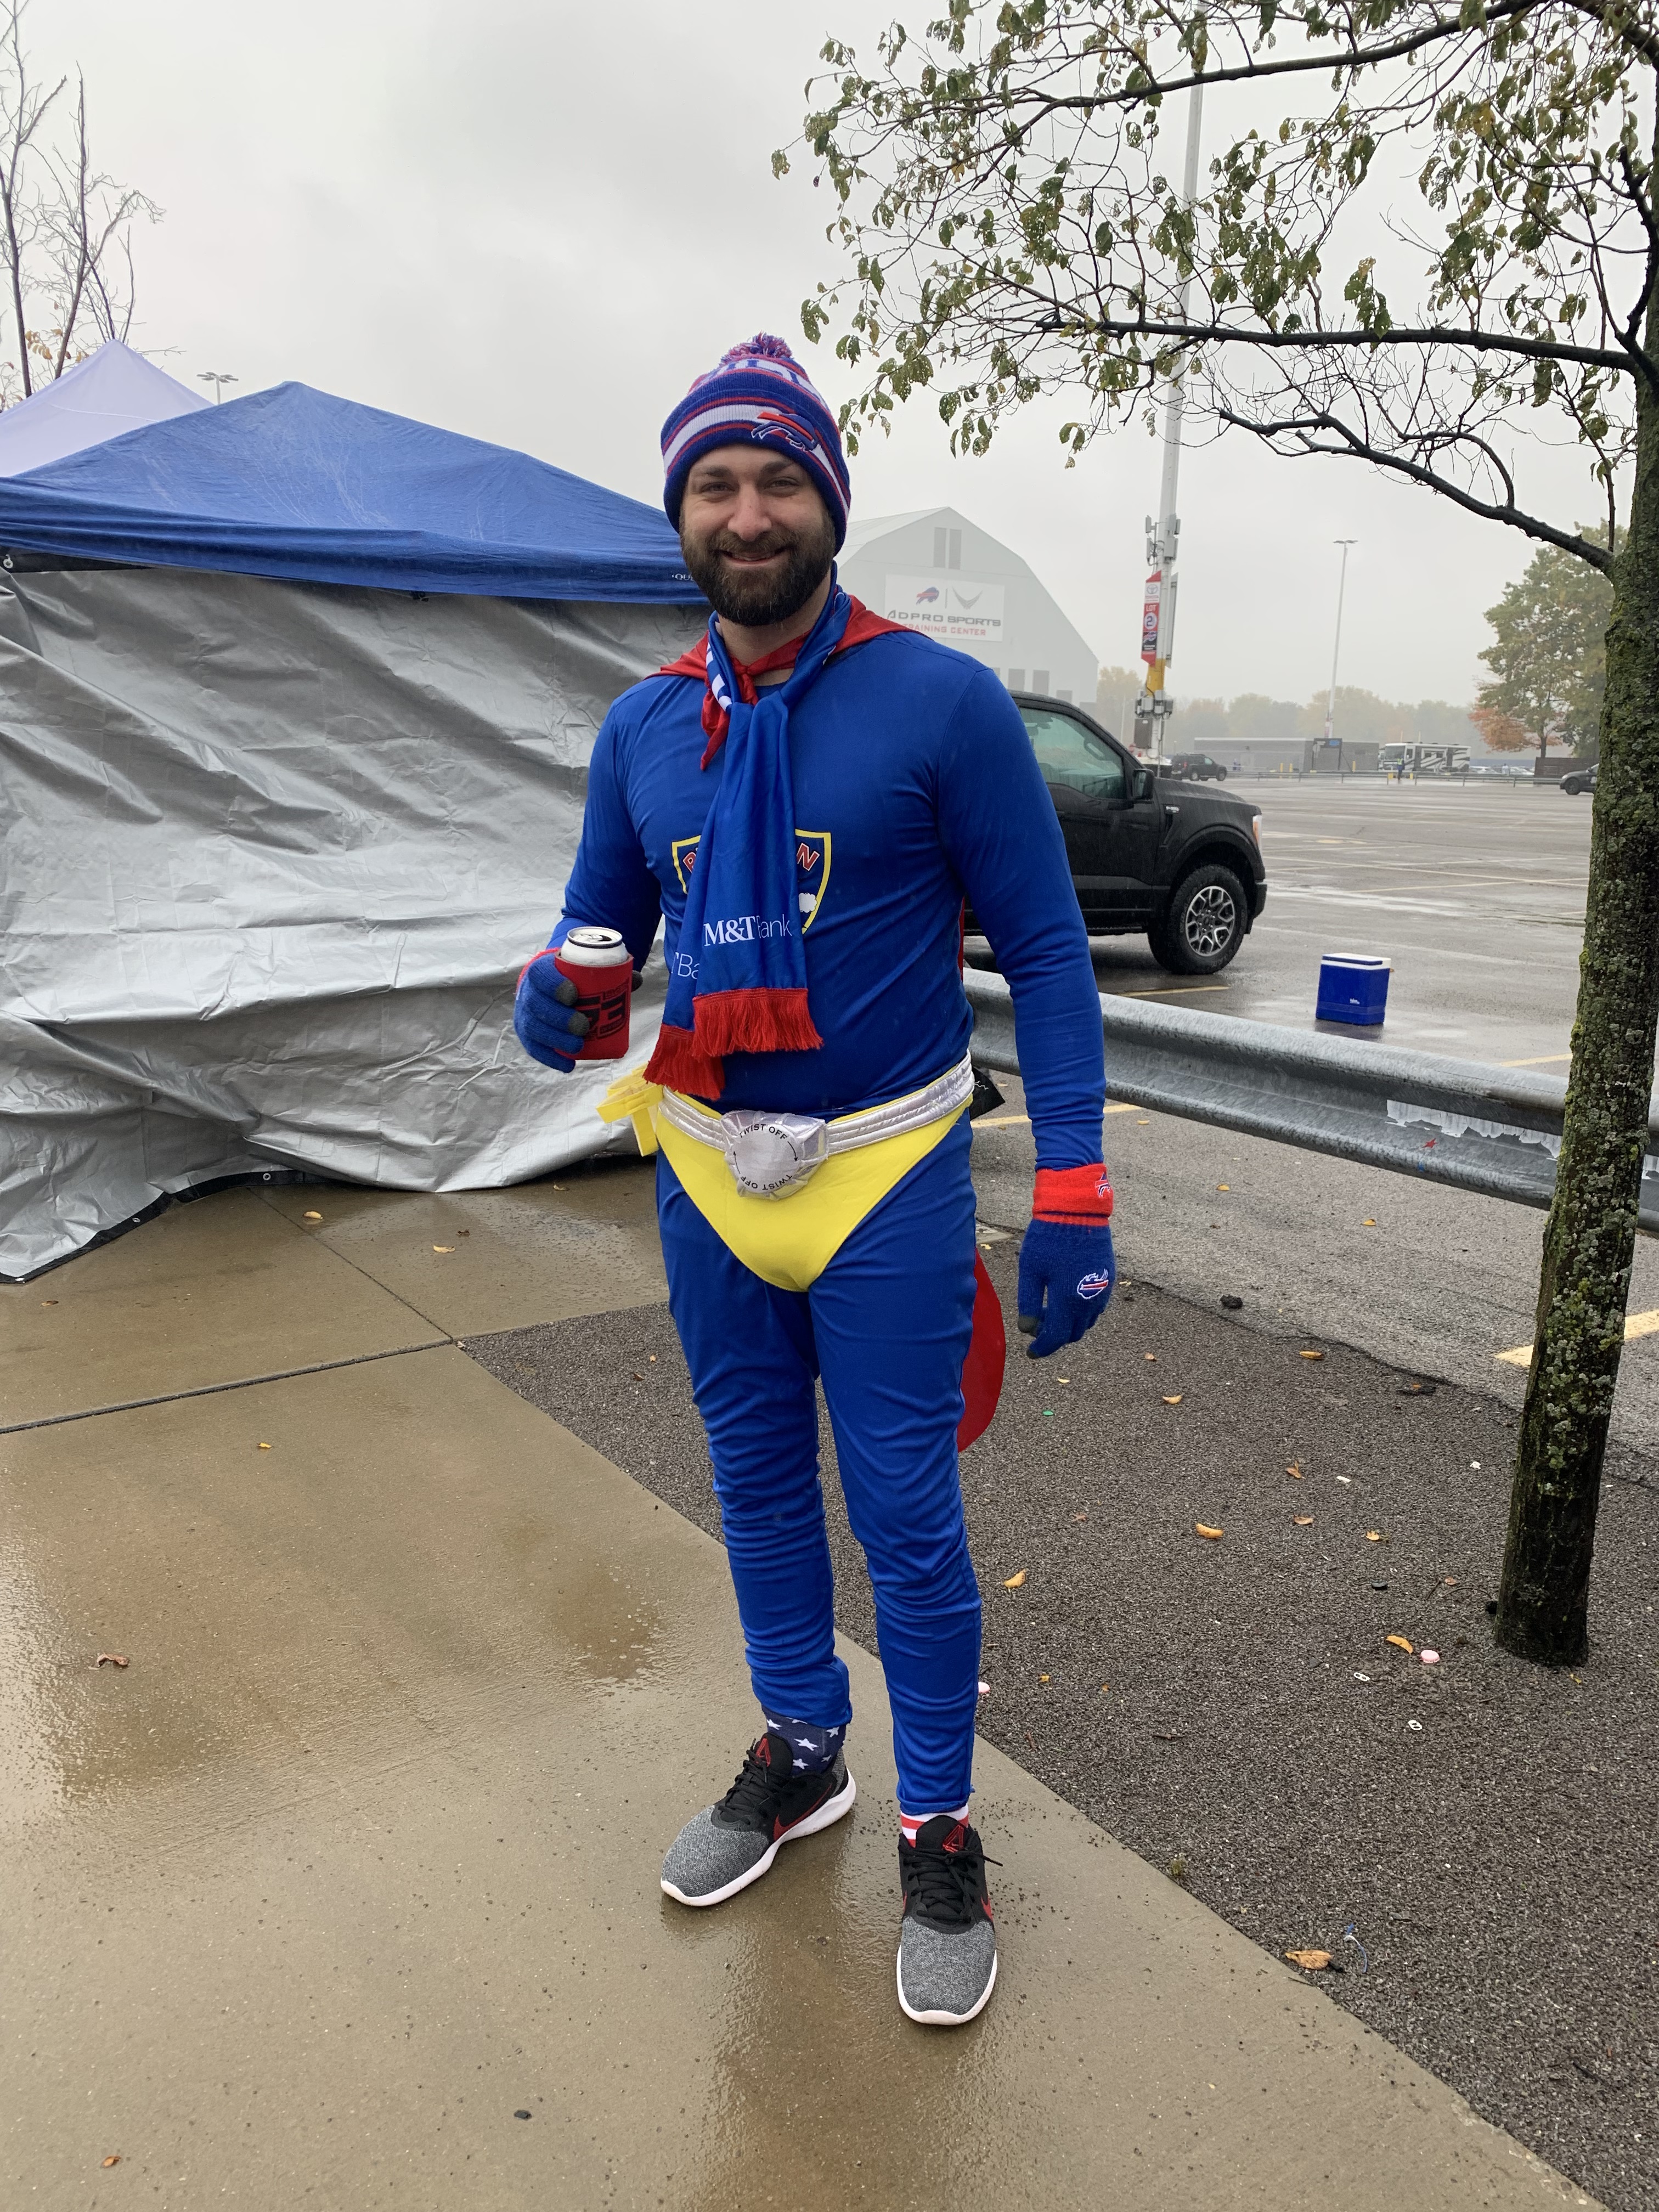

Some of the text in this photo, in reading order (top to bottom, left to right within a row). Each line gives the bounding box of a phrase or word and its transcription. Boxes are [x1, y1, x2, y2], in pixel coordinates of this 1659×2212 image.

[887, 610, 1001, 627] ADPRO SPORTS
[1147, 616, 1153, 627] 2
[951, 627, 986, 636] CENTER
[739, 1124, 788, 1139] TWIST OFF
[740, 1174, 793, 1190] TWIST OFF
